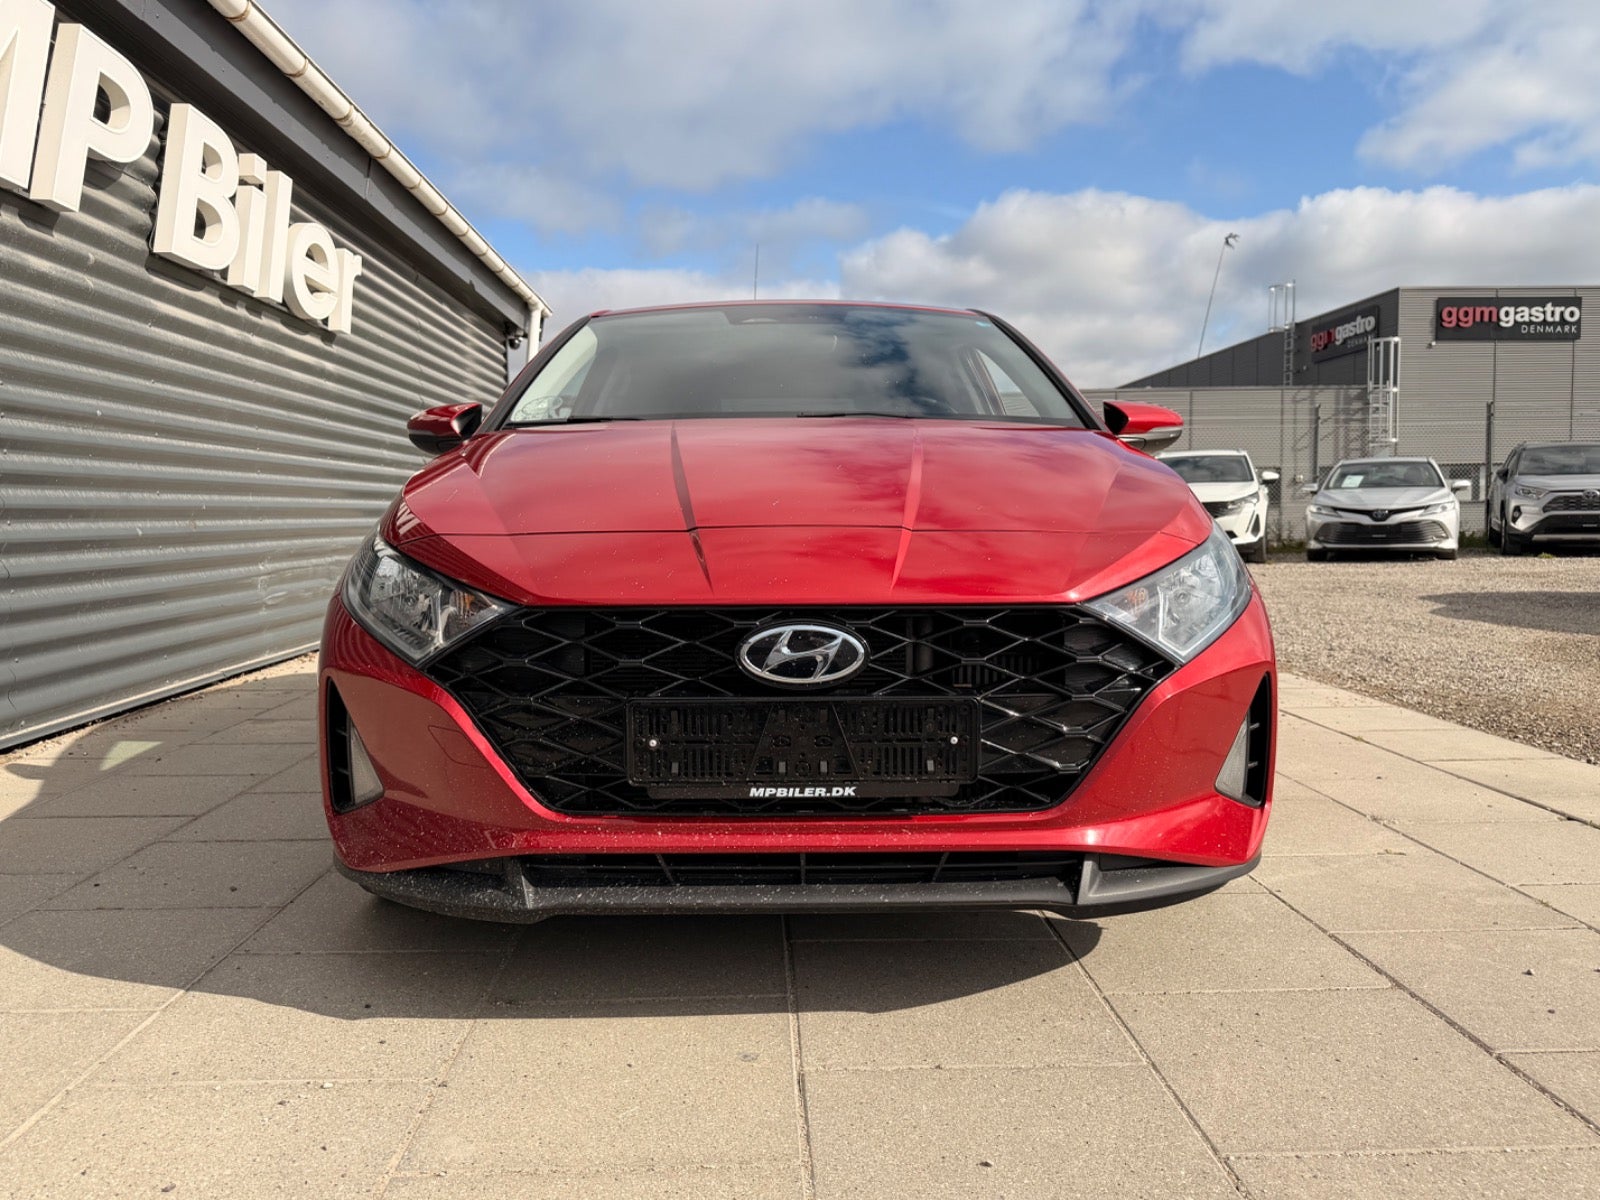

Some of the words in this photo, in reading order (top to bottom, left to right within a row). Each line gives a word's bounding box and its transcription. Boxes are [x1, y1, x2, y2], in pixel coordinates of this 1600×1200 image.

[153, 103, 363, 334] Biler
[1441, 302, 1581, 328] ggmgastro
[1521, 324, 1578, 334] DENMARK
[749, 786, 857, 798] MPBILER.DK
